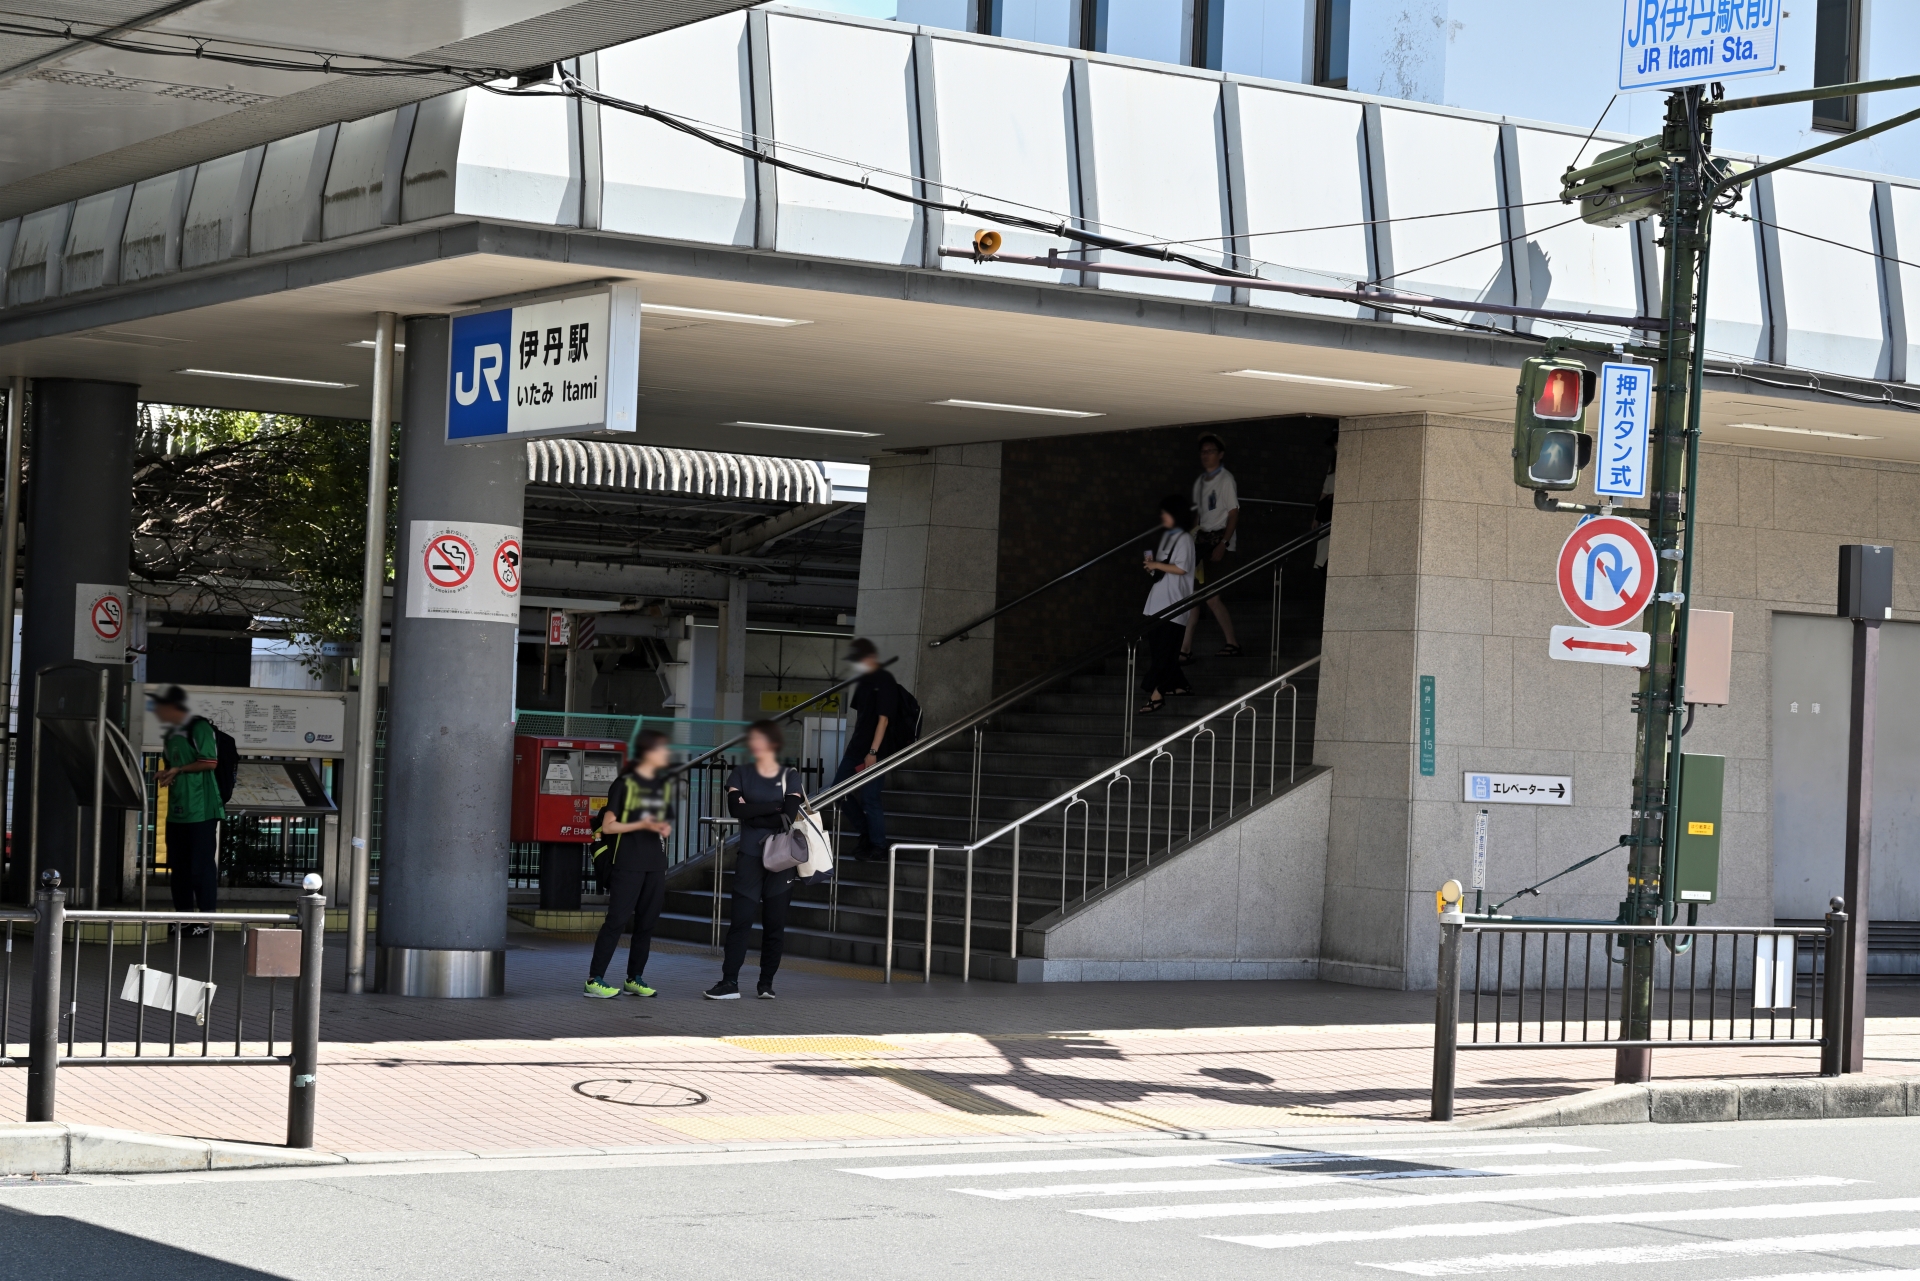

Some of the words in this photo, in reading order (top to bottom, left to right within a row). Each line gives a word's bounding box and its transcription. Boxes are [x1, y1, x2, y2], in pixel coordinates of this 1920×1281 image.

[1637, 47, 1661, 75] JR
[1668, 39, 1714, 70] Itami
[1721, 35, 1759, 63] Sta.
[519, 322, 590, 370] 伊丹駅
[455, 342, 503, 406] JR
[517, 382, 554, 407] いたみ
[562, 375, 598, 402] Itami
[1610, 374, 1638, 487] 押ボタン式
[552, 619, 561, 627] SOS
[1790, 701, 1821, 715] 倉庫
[1493, 783, 1546, 796] エレベーター
[572, 815, 587, 823] POST
